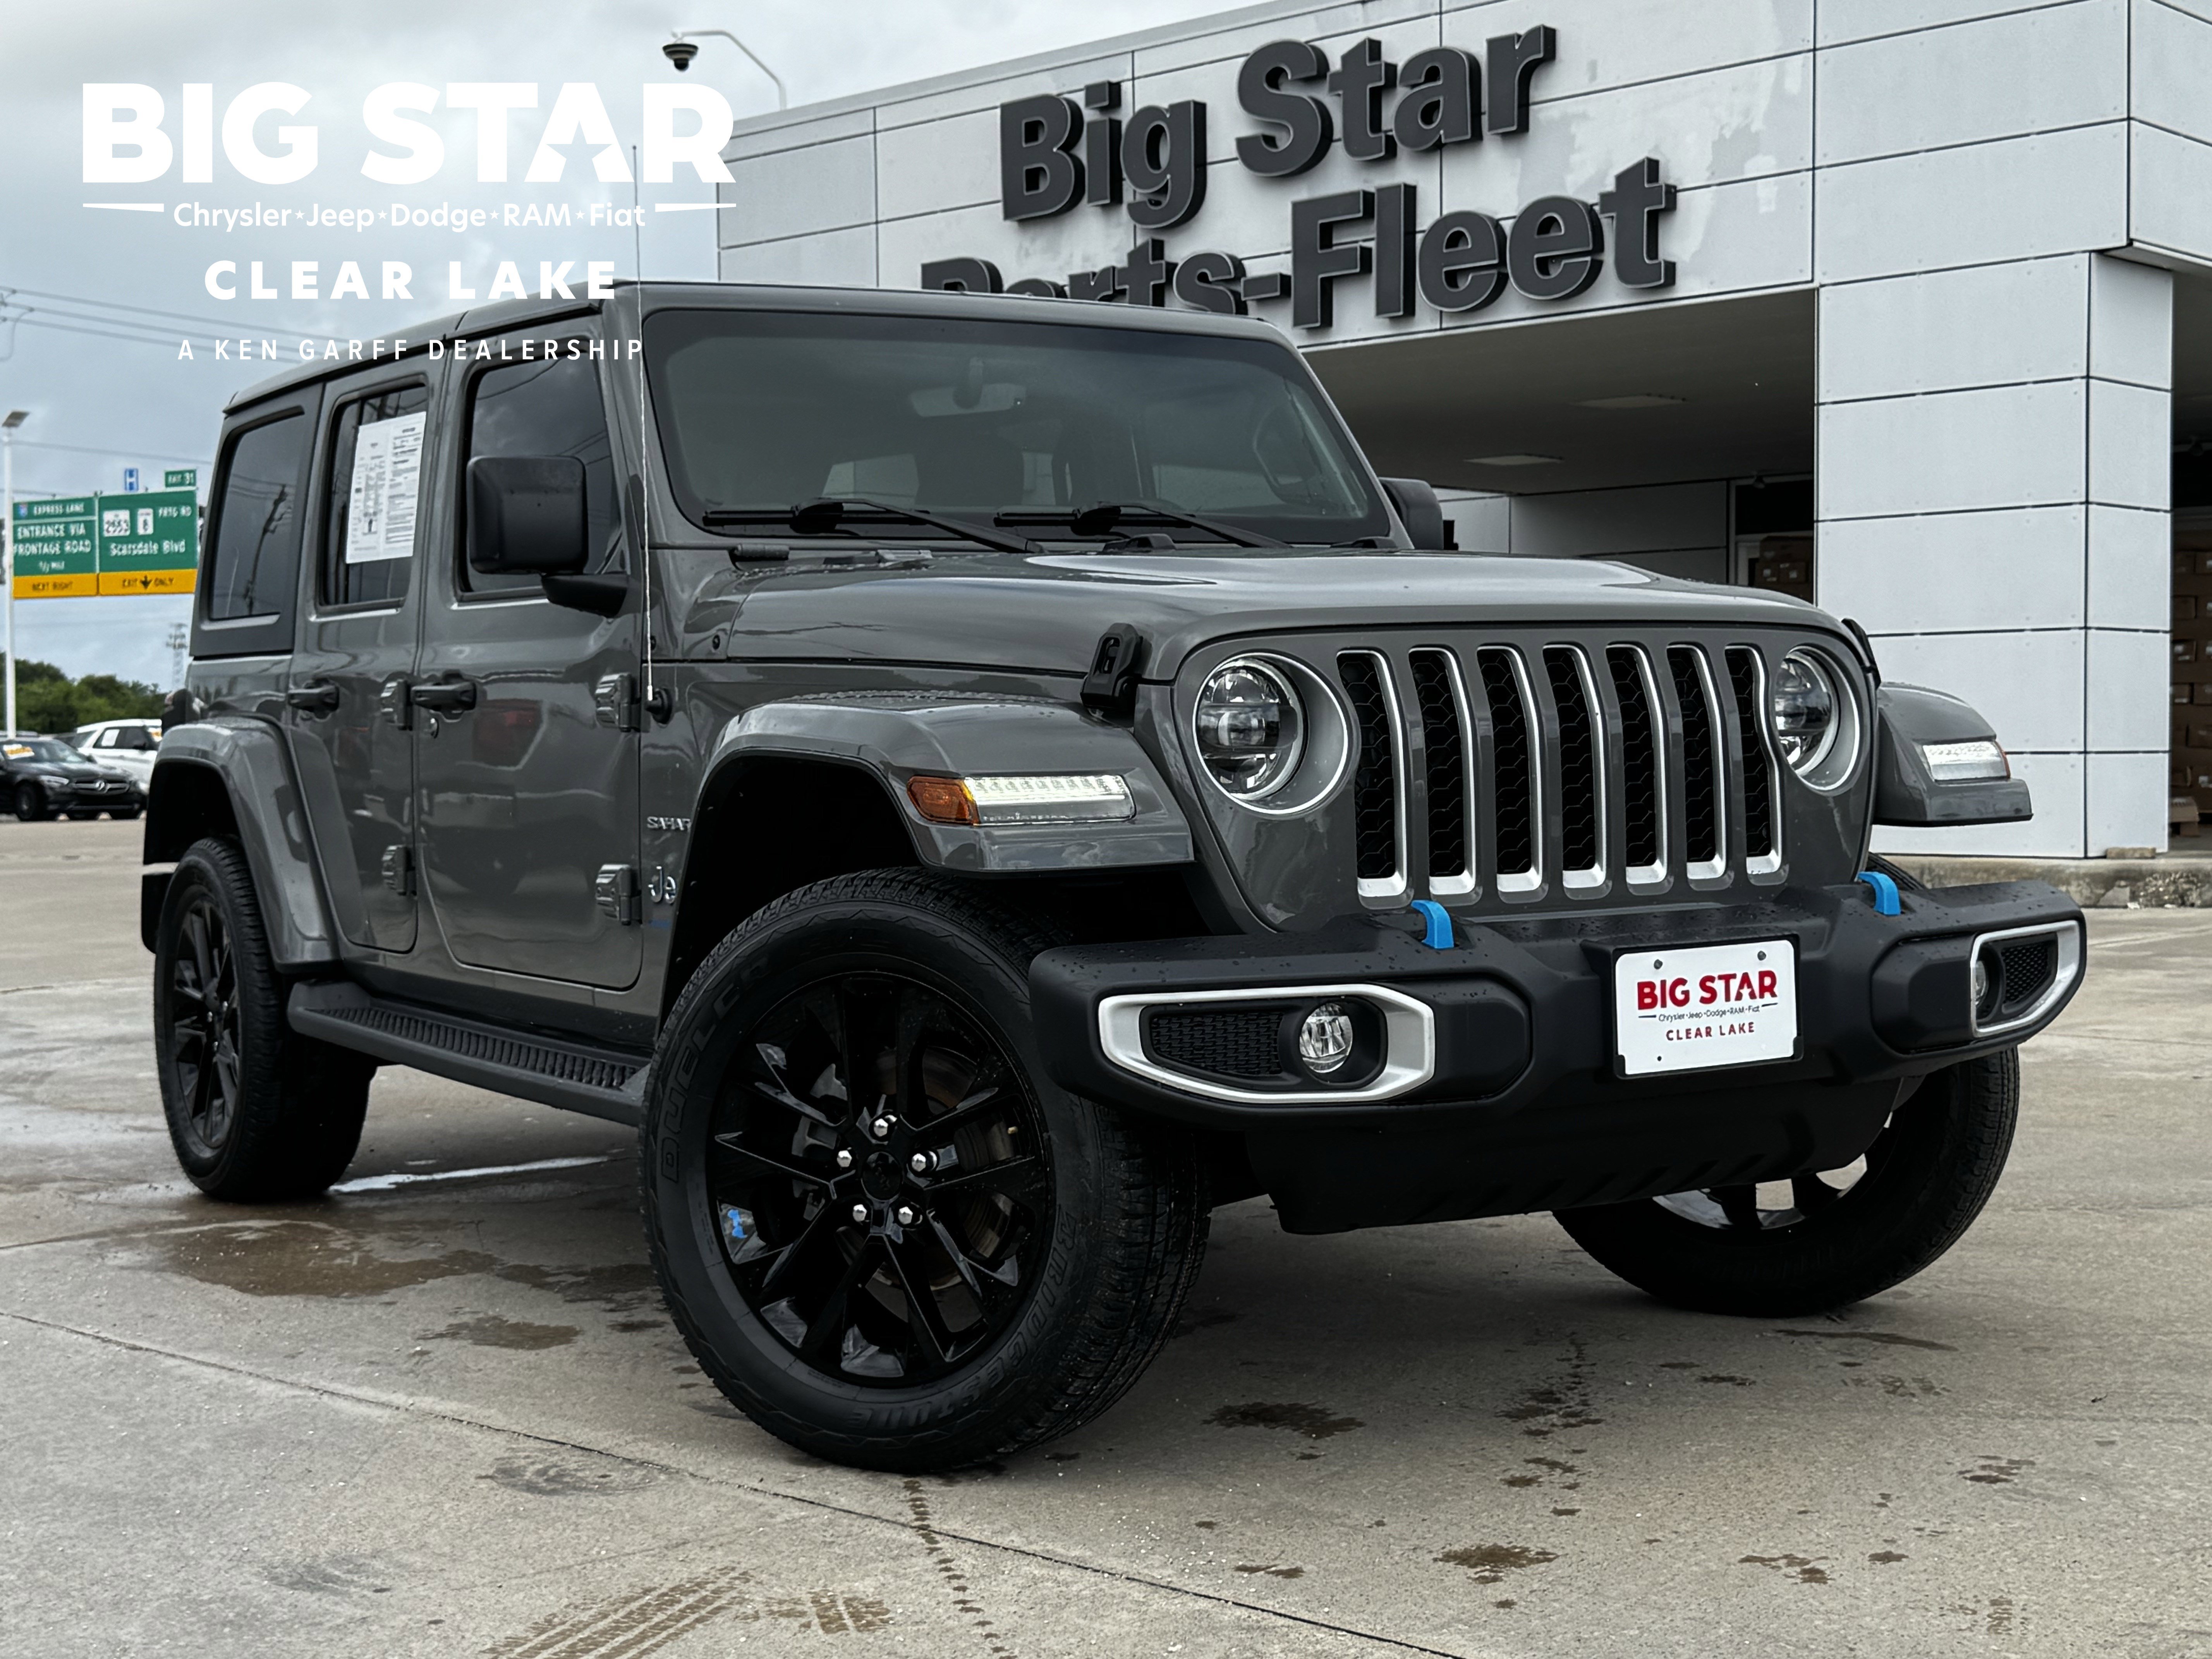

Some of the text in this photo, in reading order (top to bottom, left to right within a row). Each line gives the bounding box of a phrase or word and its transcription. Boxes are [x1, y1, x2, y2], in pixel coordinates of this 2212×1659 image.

[999, 24, 1557, 228] Big Star
[921, 156, 1677, 328] ts-Fleet
[34, 504, 63, 516] EXPRESS
[66, 502, 84, 514] LANE
[17, 522, 86, 540] ENTRANCE VIA
[14, 539, 91, 556] FRONTAGE ROAD
[110, 539, 185, 556] Scarsdale Blvd
[122, 577, 174, 588] EXIT ONLY
[1637, 970, 1778, 1010] BIG STAR
[1659, 1013, 1685, 1023] Chrysler
[1688, 1012, 1703, 1020] Jeep
[1706, 1009, 1727, 1018] Dodge
[1729, 1006, 1745, 1015] RAM
[1666, 1022, 1755, 1041] CLEAR LAKE
